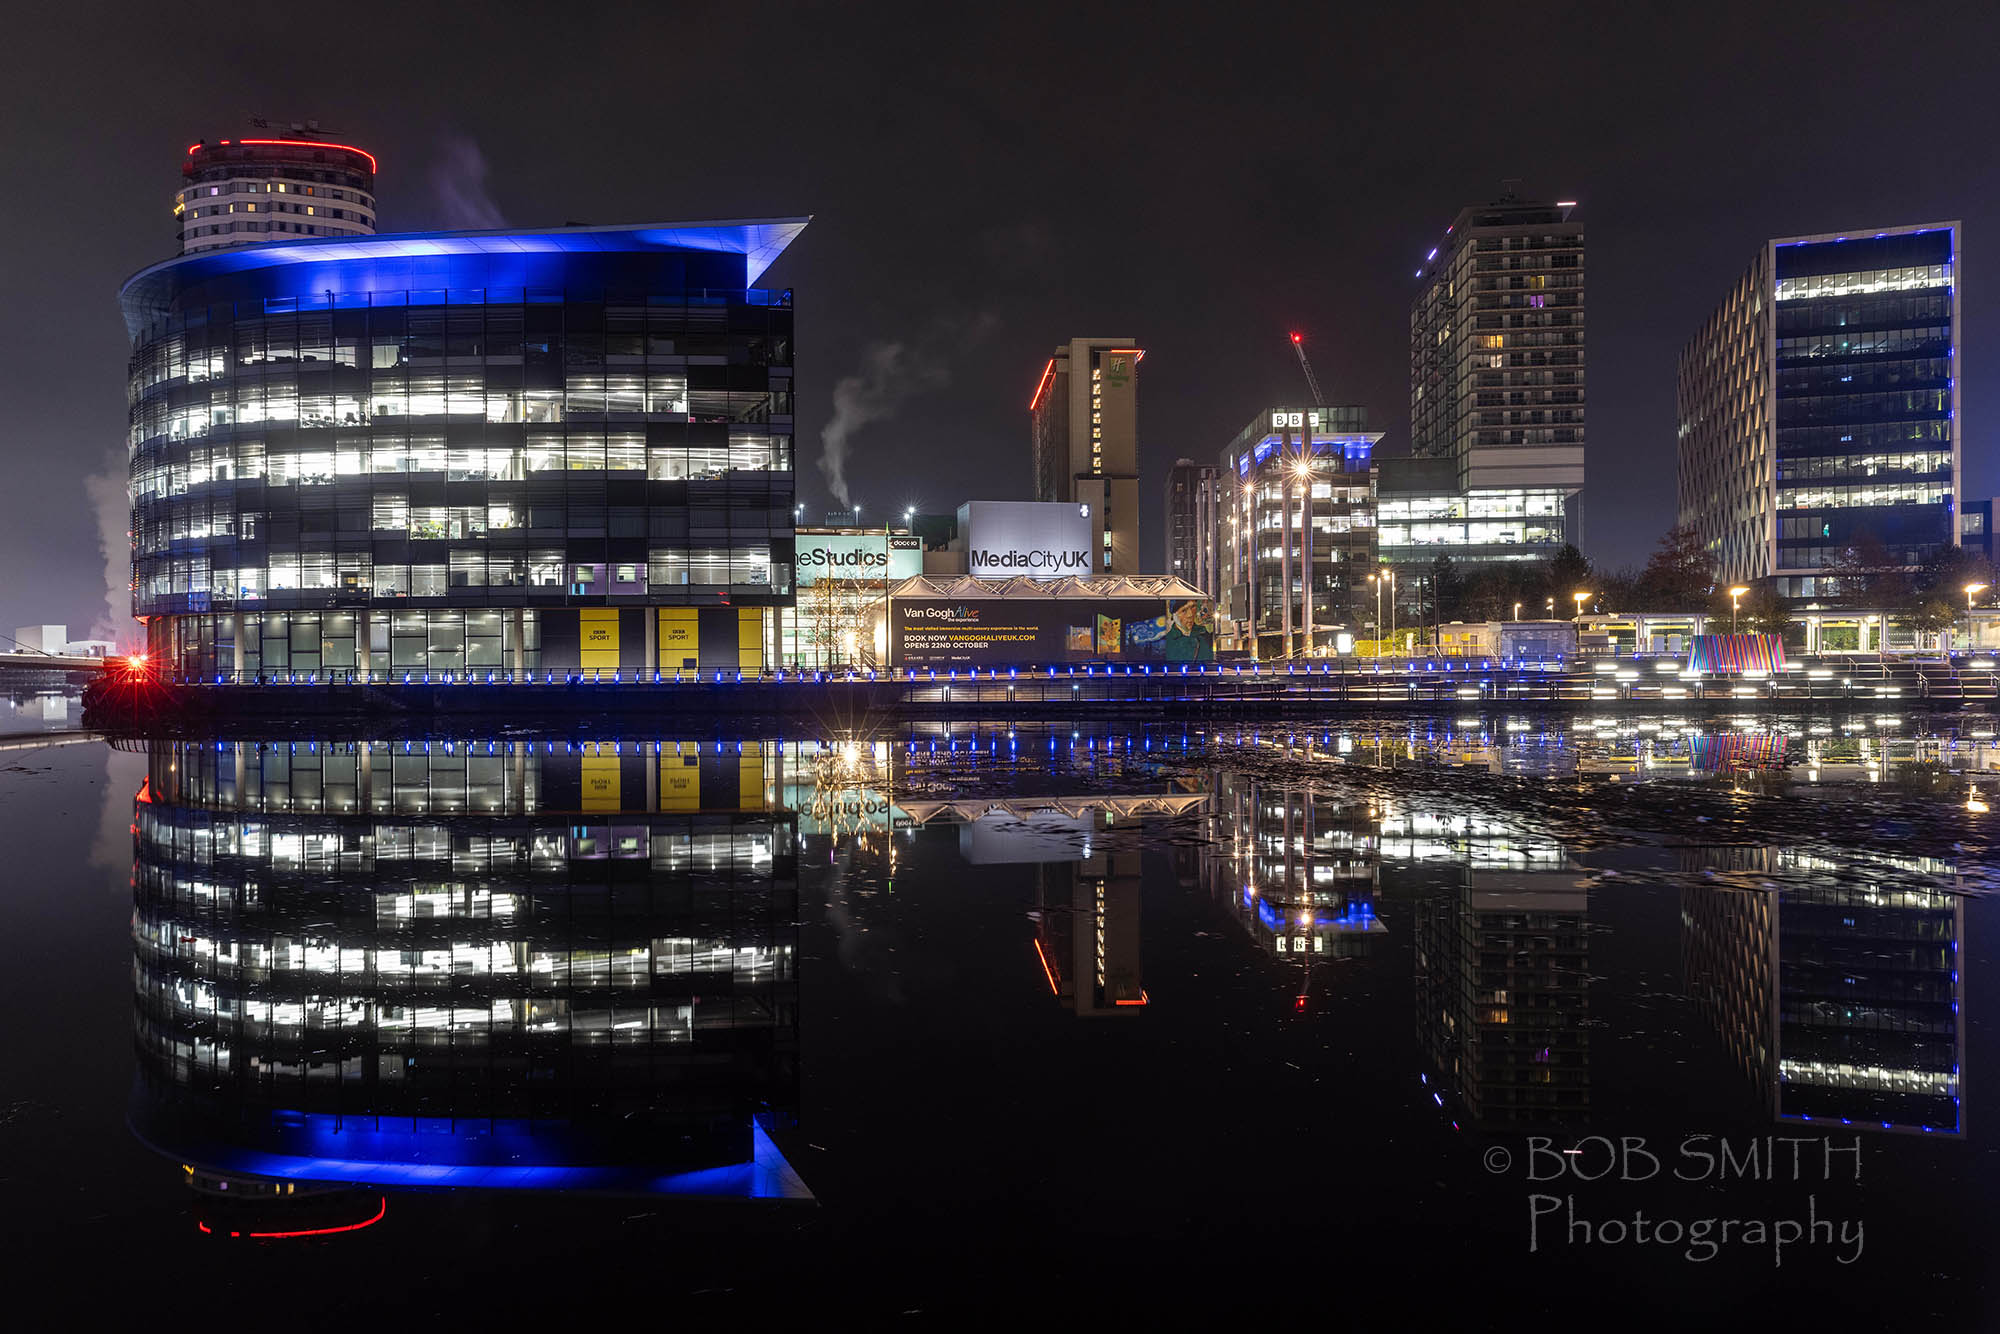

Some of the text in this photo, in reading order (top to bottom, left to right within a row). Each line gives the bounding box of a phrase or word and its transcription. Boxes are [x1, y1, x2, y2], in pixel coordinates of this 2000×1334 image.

[971, 550, 1089, 573] MediaCityUK
[904, 608, 924, 618] Van
[925, 607, 954, 620] Gogh
